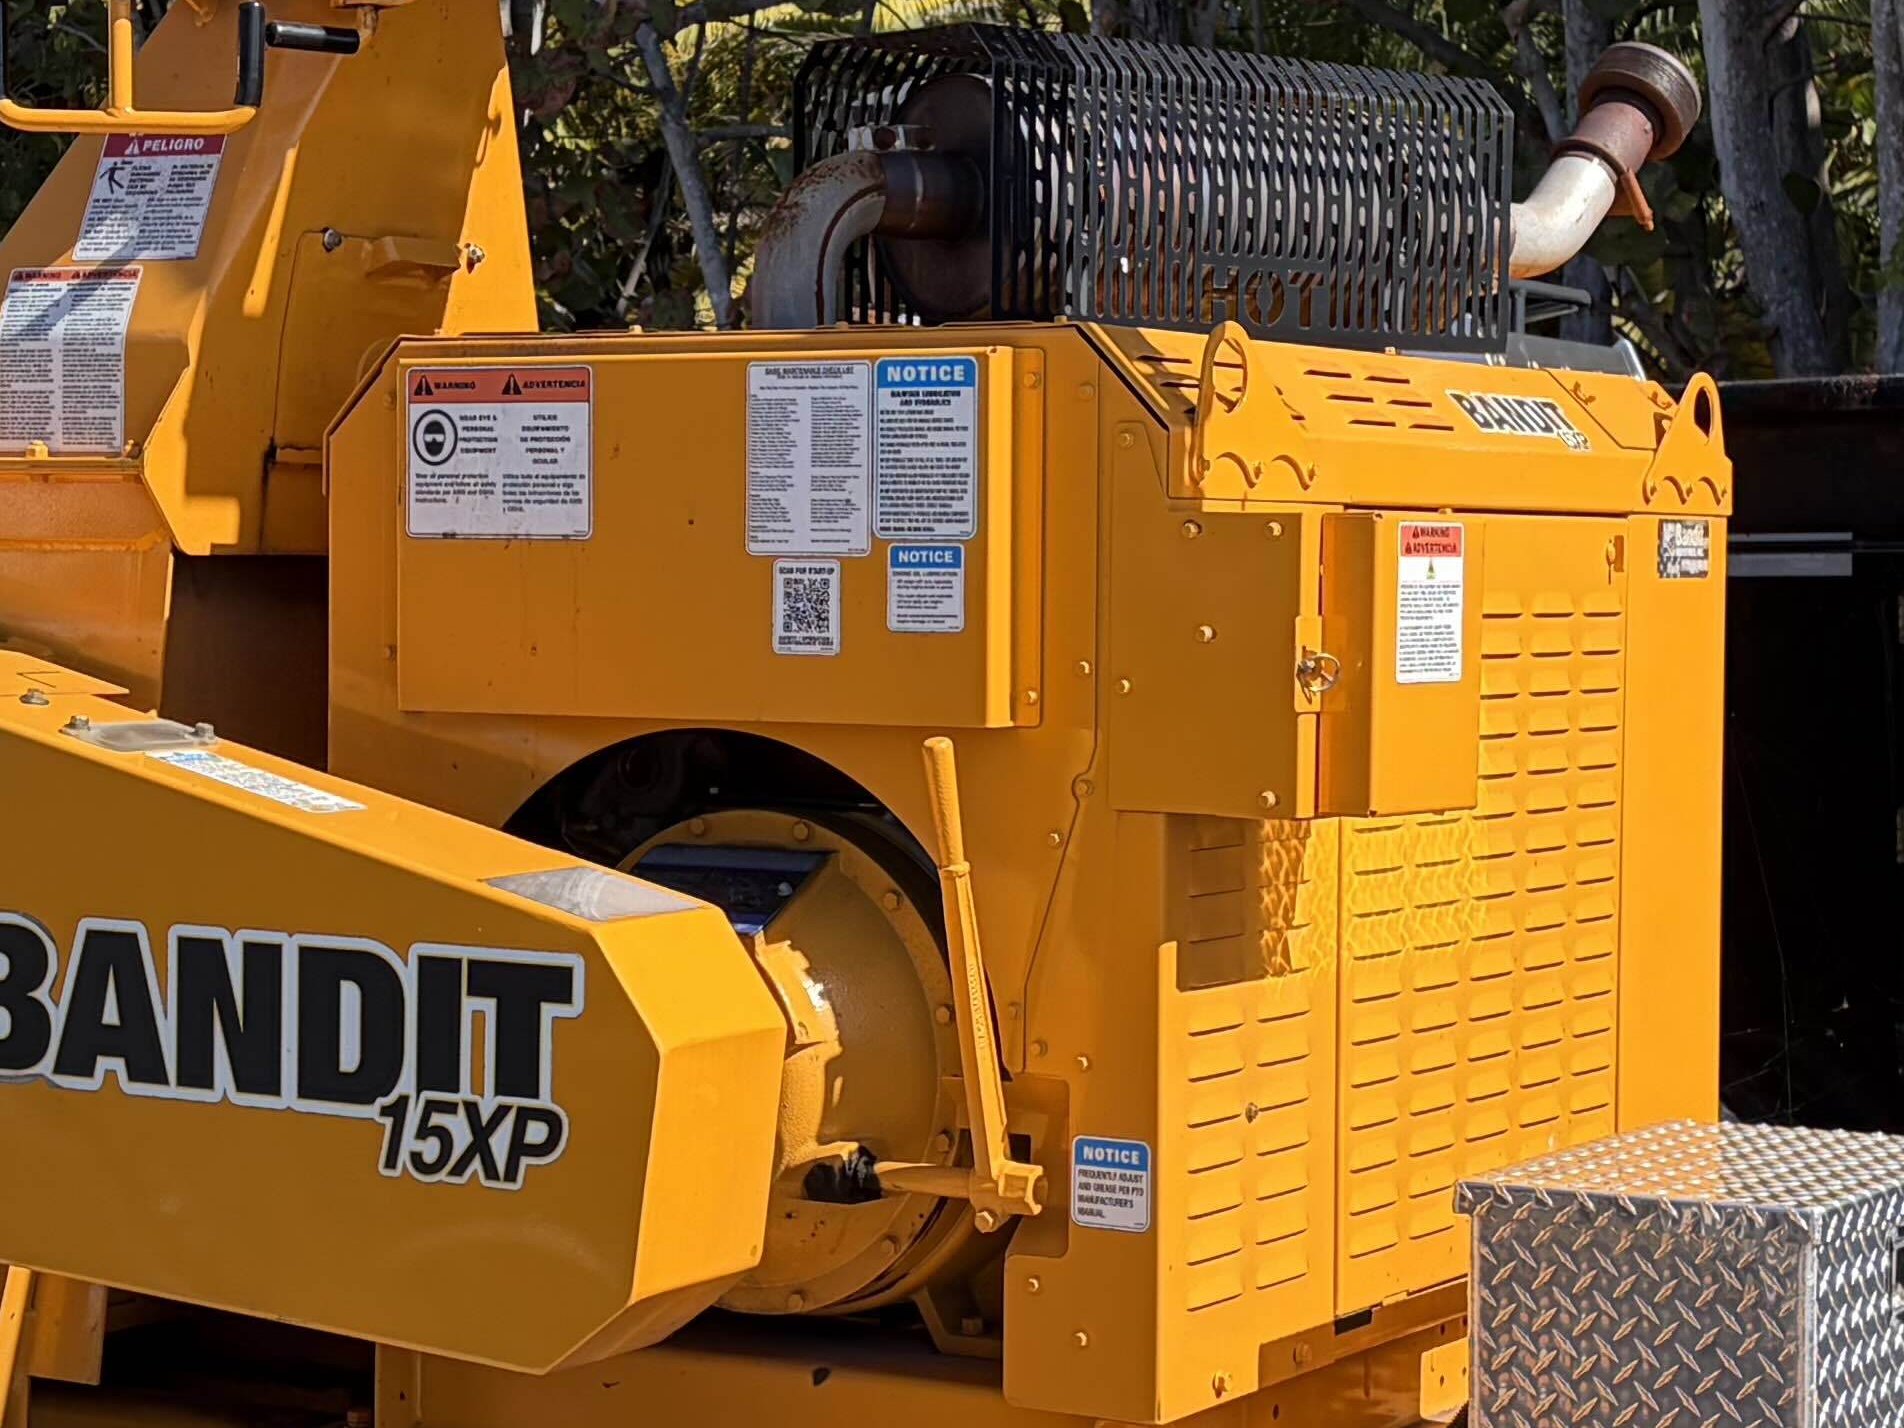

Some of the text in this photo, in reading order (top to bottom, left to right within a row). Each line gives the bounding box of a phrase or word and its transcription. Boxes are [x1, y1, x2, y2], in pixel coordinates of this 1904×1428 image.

[142, 138, 205, 152] PELIGRO
[887, 365, 965, 382] NOTICE
[1449, 393, 1574, 433] BANDIT
[898, 551, 954, 563] NOTICE
[379, 1096, 563, 1184] 15XP
[1083, 1146, 1140, 1164] NOTICE
[1078, 1169, 1144, 1183] FREQUENTLY ADJUST
